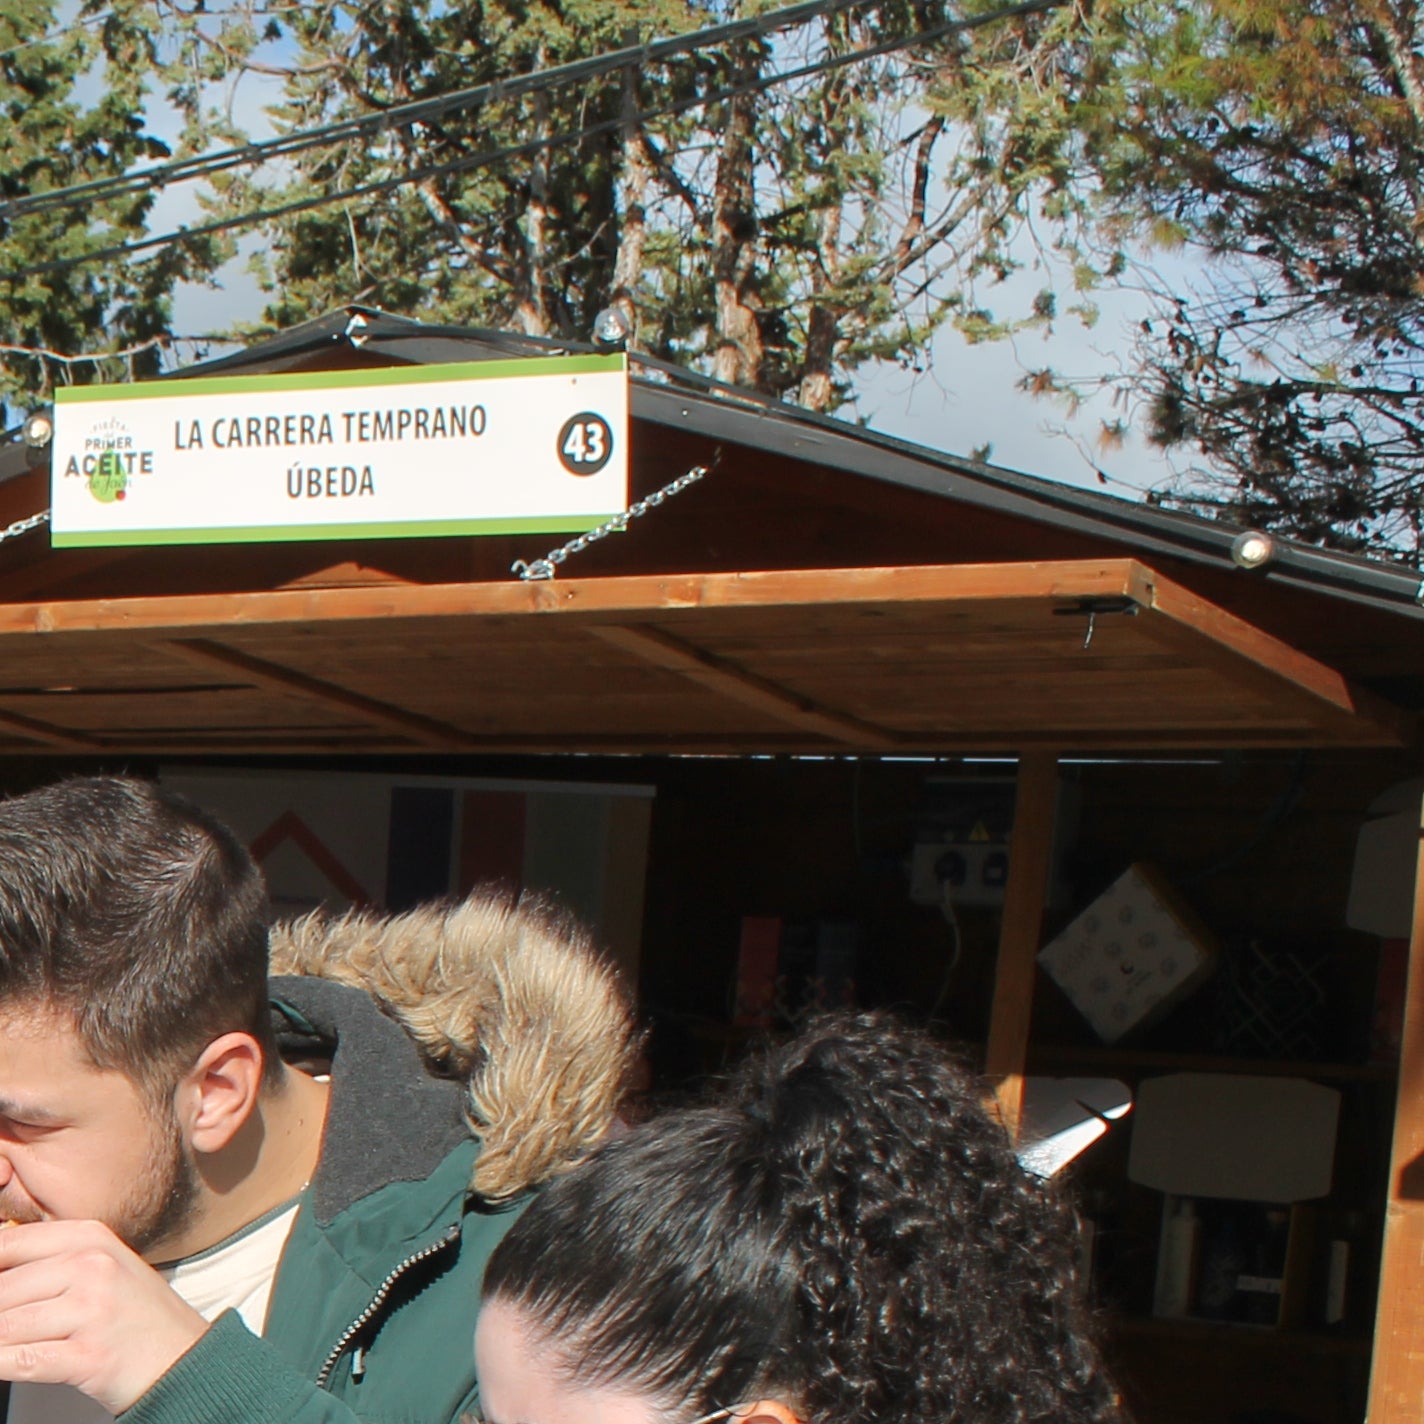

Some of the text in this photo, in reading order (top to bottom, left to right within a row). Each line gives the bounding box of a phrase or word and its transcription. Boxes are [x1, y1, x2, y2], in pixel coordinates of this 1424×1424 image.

[84, 437, 133, 450] PRIMER
[174, 405, 488, 451] LA CARRERA TEMPRANO
[562, 421, 605, 462] 43
[64, 451, 154, 477] ACEITE
[286, 462, 376, 499] ÚBEDA
